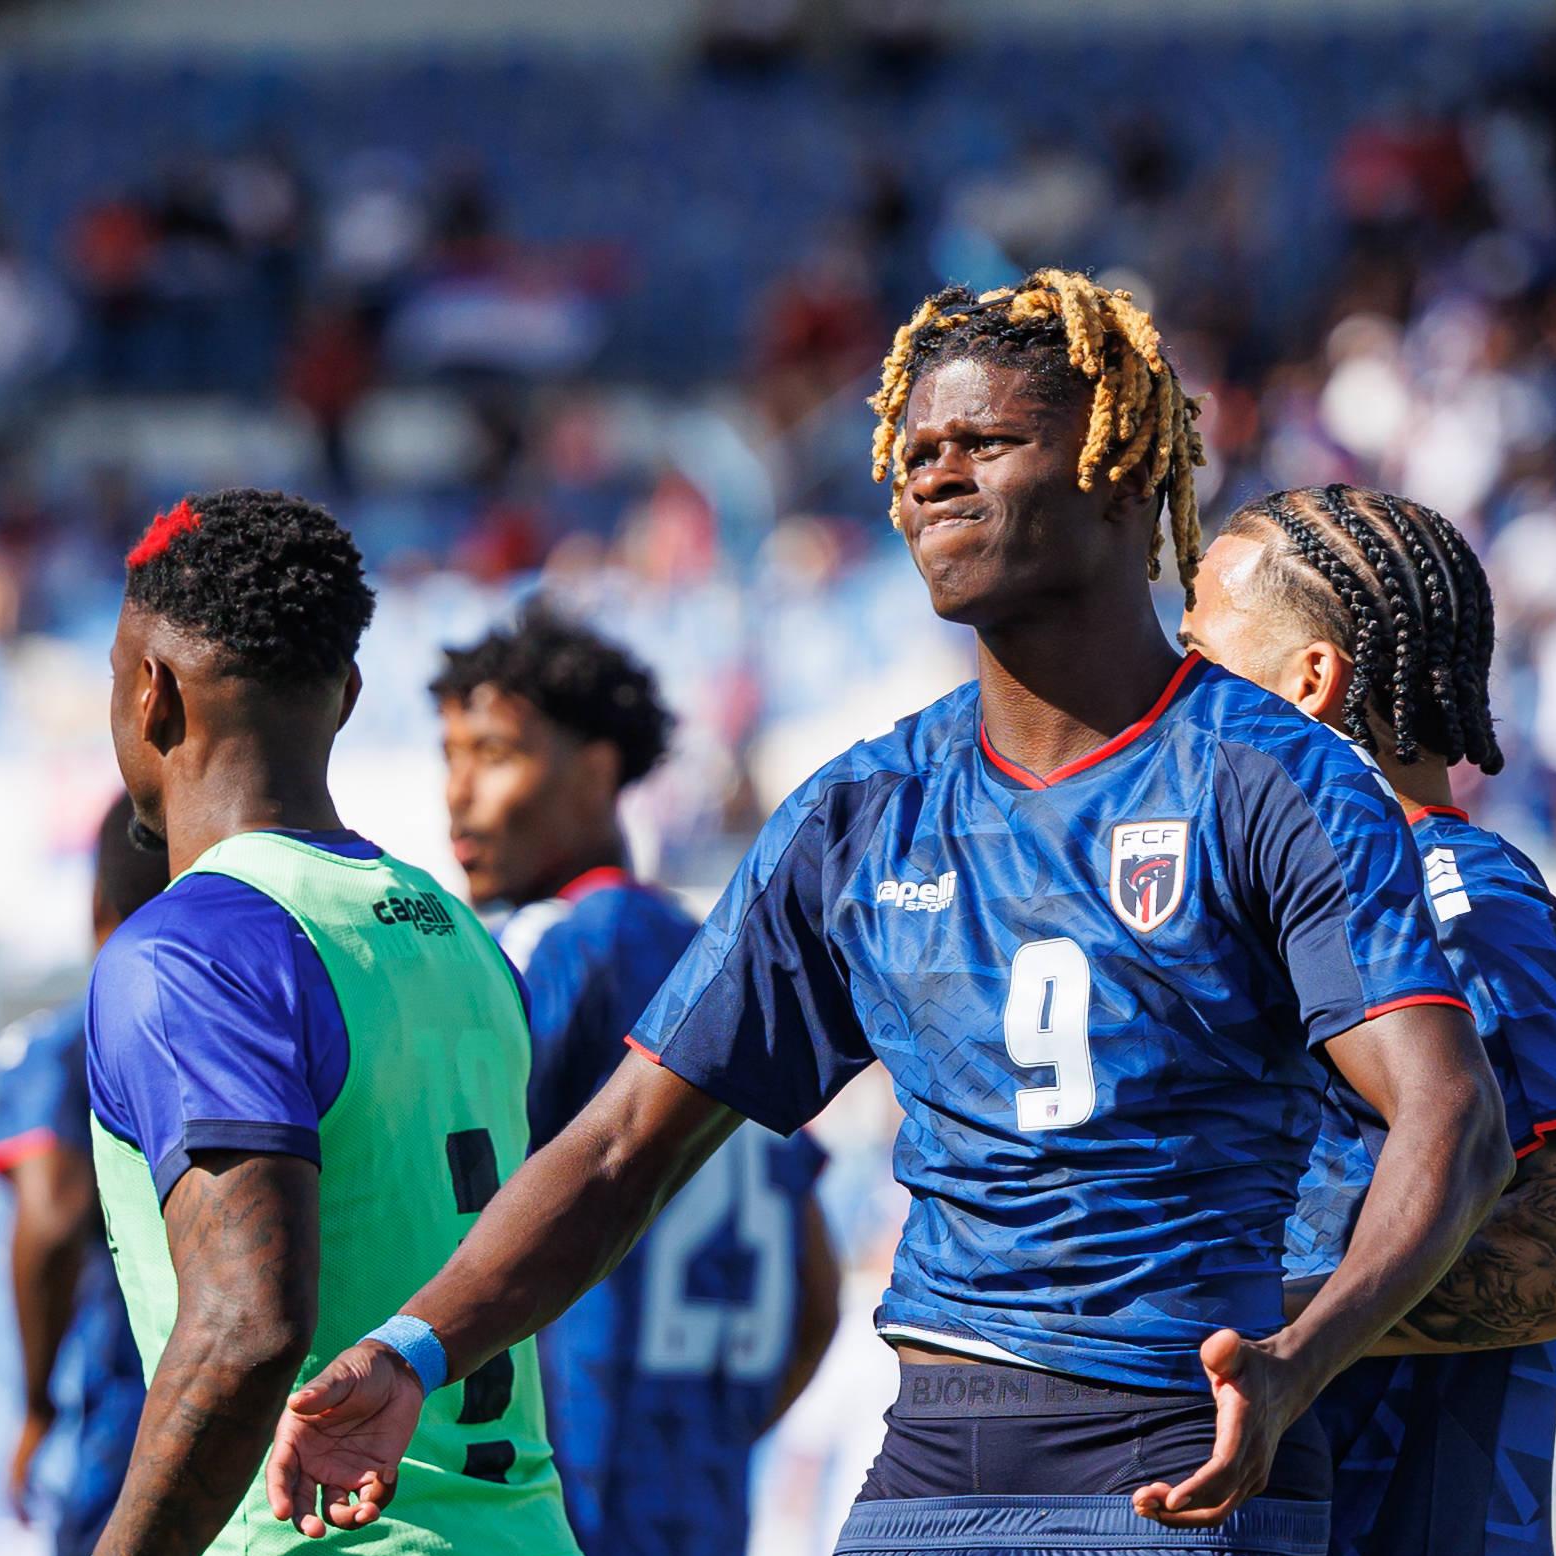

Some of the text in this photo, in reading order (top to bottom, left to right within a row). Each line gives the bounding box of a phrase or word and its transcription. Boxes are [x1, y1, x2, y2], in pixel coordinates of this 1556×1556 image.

[1120, 828, 1181, 848] FCF
[372, 891, 453, 931] capelli
[904, 897, 954, 913] SPORT
[1004, 937, 1096, 1131] 9
